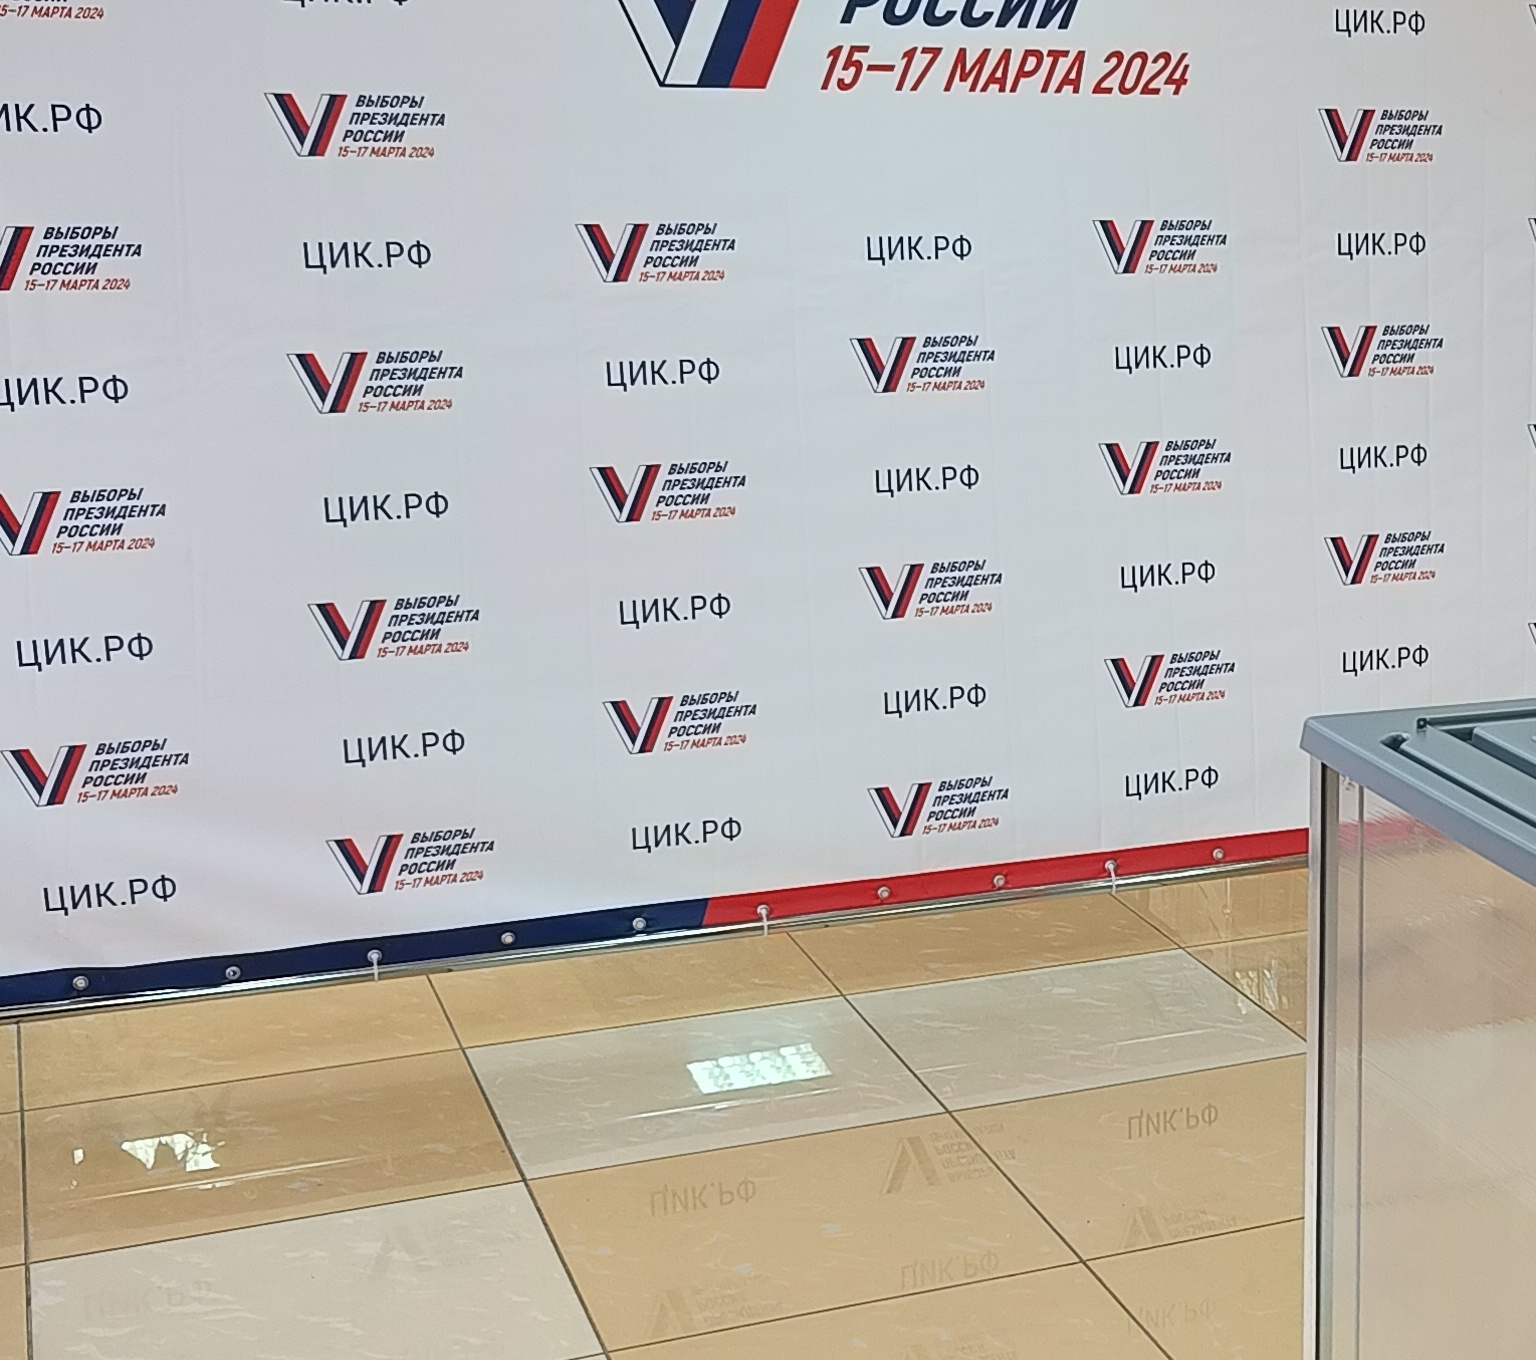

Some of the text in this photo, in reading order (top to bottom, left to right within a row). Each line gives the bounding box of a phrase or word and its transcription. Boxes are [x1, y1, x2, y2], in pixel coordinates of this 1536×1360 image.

[0, 5, 104, 19] 5–17 МАРТА 2024
[1336, 9, 1425, 37] ЦИК.РФ
[944, 48, 1086, 96] МАРТА
[1092, 51, 1191, 97] 2024
[355, 95, 424, 108] ВЫБОРЫ
[348, 112, 445, 126] ПРЕЗИДЕНТА
[342, 129, 405, 142] РОССИИ
[369, 146, 406, 157] МАРТА
[408, 147, 435, 158] 2024
[655, 223, 717, 235] ВЫБОРЫ
[1160, 220, 1212, 230] ВЫБОРЫ
[43, 227, 118, 239] ВЫБОРЫ
[1154, 234, 1227, 245] ПРЕЗИДЕНТА
[36, 244, 141, 257] ПРЕЗИДЕНТА
[649, 239, 735, 251] ПРЕЗИДЕНТА
[867, 235, 971, 266] ЦИК.РФ
[1338, 232, 1426, 260] ЦИК.РФ
[303, 240, 431, 274] ЦИК.РФ
[643, 255, 699, 267] РОССИИ
[1148, 249, 1196, 260] РОССИИ
[29, 262, 98, 275] РОССИИ
[59, 279, 99, 290] МАРТА
[102, 279, 130, 290] 2024
[375, 350, 443, 363] ВЫБОРЫ
[1115, 344, 1211, 374] ЦИК.РФ
[369, 366, 463, 380] ПРЕЗИДЕНТА
[606, 358, 719, 392] ЦИК.РФ
[362, 384, 424, 397] РОССИИ
[389, 400, 425, 411] МАРТА
[427, 399, 453, 410] 2024
[1340, 443, 1427, 474] ЦИК.РФ
[876, 464, 979, 498] ЦИК.РФ
[70, 488, 143, 503] ВЫБОРЫ
[63, 504, 166, 520] ПРЕЗИДЕНТА
[324, 491, 448, 528] ЦИК.РФ
[56, 523, 123, 538] РОССИИ
[1384, 531, 1431, 543] ВЫБОРЫ
[85, 539, 125, 551] МАРТА
[127, 538, 155, 549] 2024
[1379, 543, 1444, 557] ПРЕЗИДЕНТА
[930, 559, 986, 573] ВЫБОРЫ
[1373, 559, 1416, 571] РОССИИ
[924, 573, 1002, 588] ПРЕЗИДЕНТА
[1121, 560, 1215, 593] ЦИК.РФ
[394, 595, 460, 610] ВЫБОРЫ
[918, 590, 969, 603] РОССИИ
[387, 609, 479, 626] ПРЕЗИДЕНТА
[620, 593, 730, 629] ЦИК.РФ
[381, 628, 441, 643] РОССИИ
[17, 633, 153, 672] ЦИК.РФ
[407, 643, 442, 655] МАРТА
[444, 641, 469, 653] 2024
[1169, 650, 1220, 663] ВЫБОРЫ
[1343, 645, 1428, 677] ЦИК.РФ
[1164, 662, 1235, 678] ПРЕЗИДЕНТА
[1158, 679, 1205, 692] РОССИИ
[679, 690, 739, 706] ВЫБОРЫ
[884, 683, 986, 718] ЦИК.РФ
[673, 704, 756, 722] ПРЕЗИДЕНТА
[667, 722, 722, 737] РОССИИ
[95, 738, 167, 755] ВЫБОРЫ
[343, 729, 464, 767] ЦИК.РФ
[88, 753, 189, 771] ПРЕЗИДЕНТА
[81, 772, 147, 788] РОССИИ
[1126, 766, 1218, 800] ЦИК.РФ
[110, 787, 148, 800] МАРТА
[151, 785, 178, 796] 2024
[410, 827, 474, 843] ВЫБОРЫ
[632, 817, 741, 853] ЦИК.РФ
[404, 840, 494, 859] ПРЕЗИДЕНТА
[398, 859, 457, 875] РОССИИ
[423, 874, 457, 886] МАРТА
[459, 871, 484, 882] 2024
[43, 875, 176, 916] ЦИК.РФ
